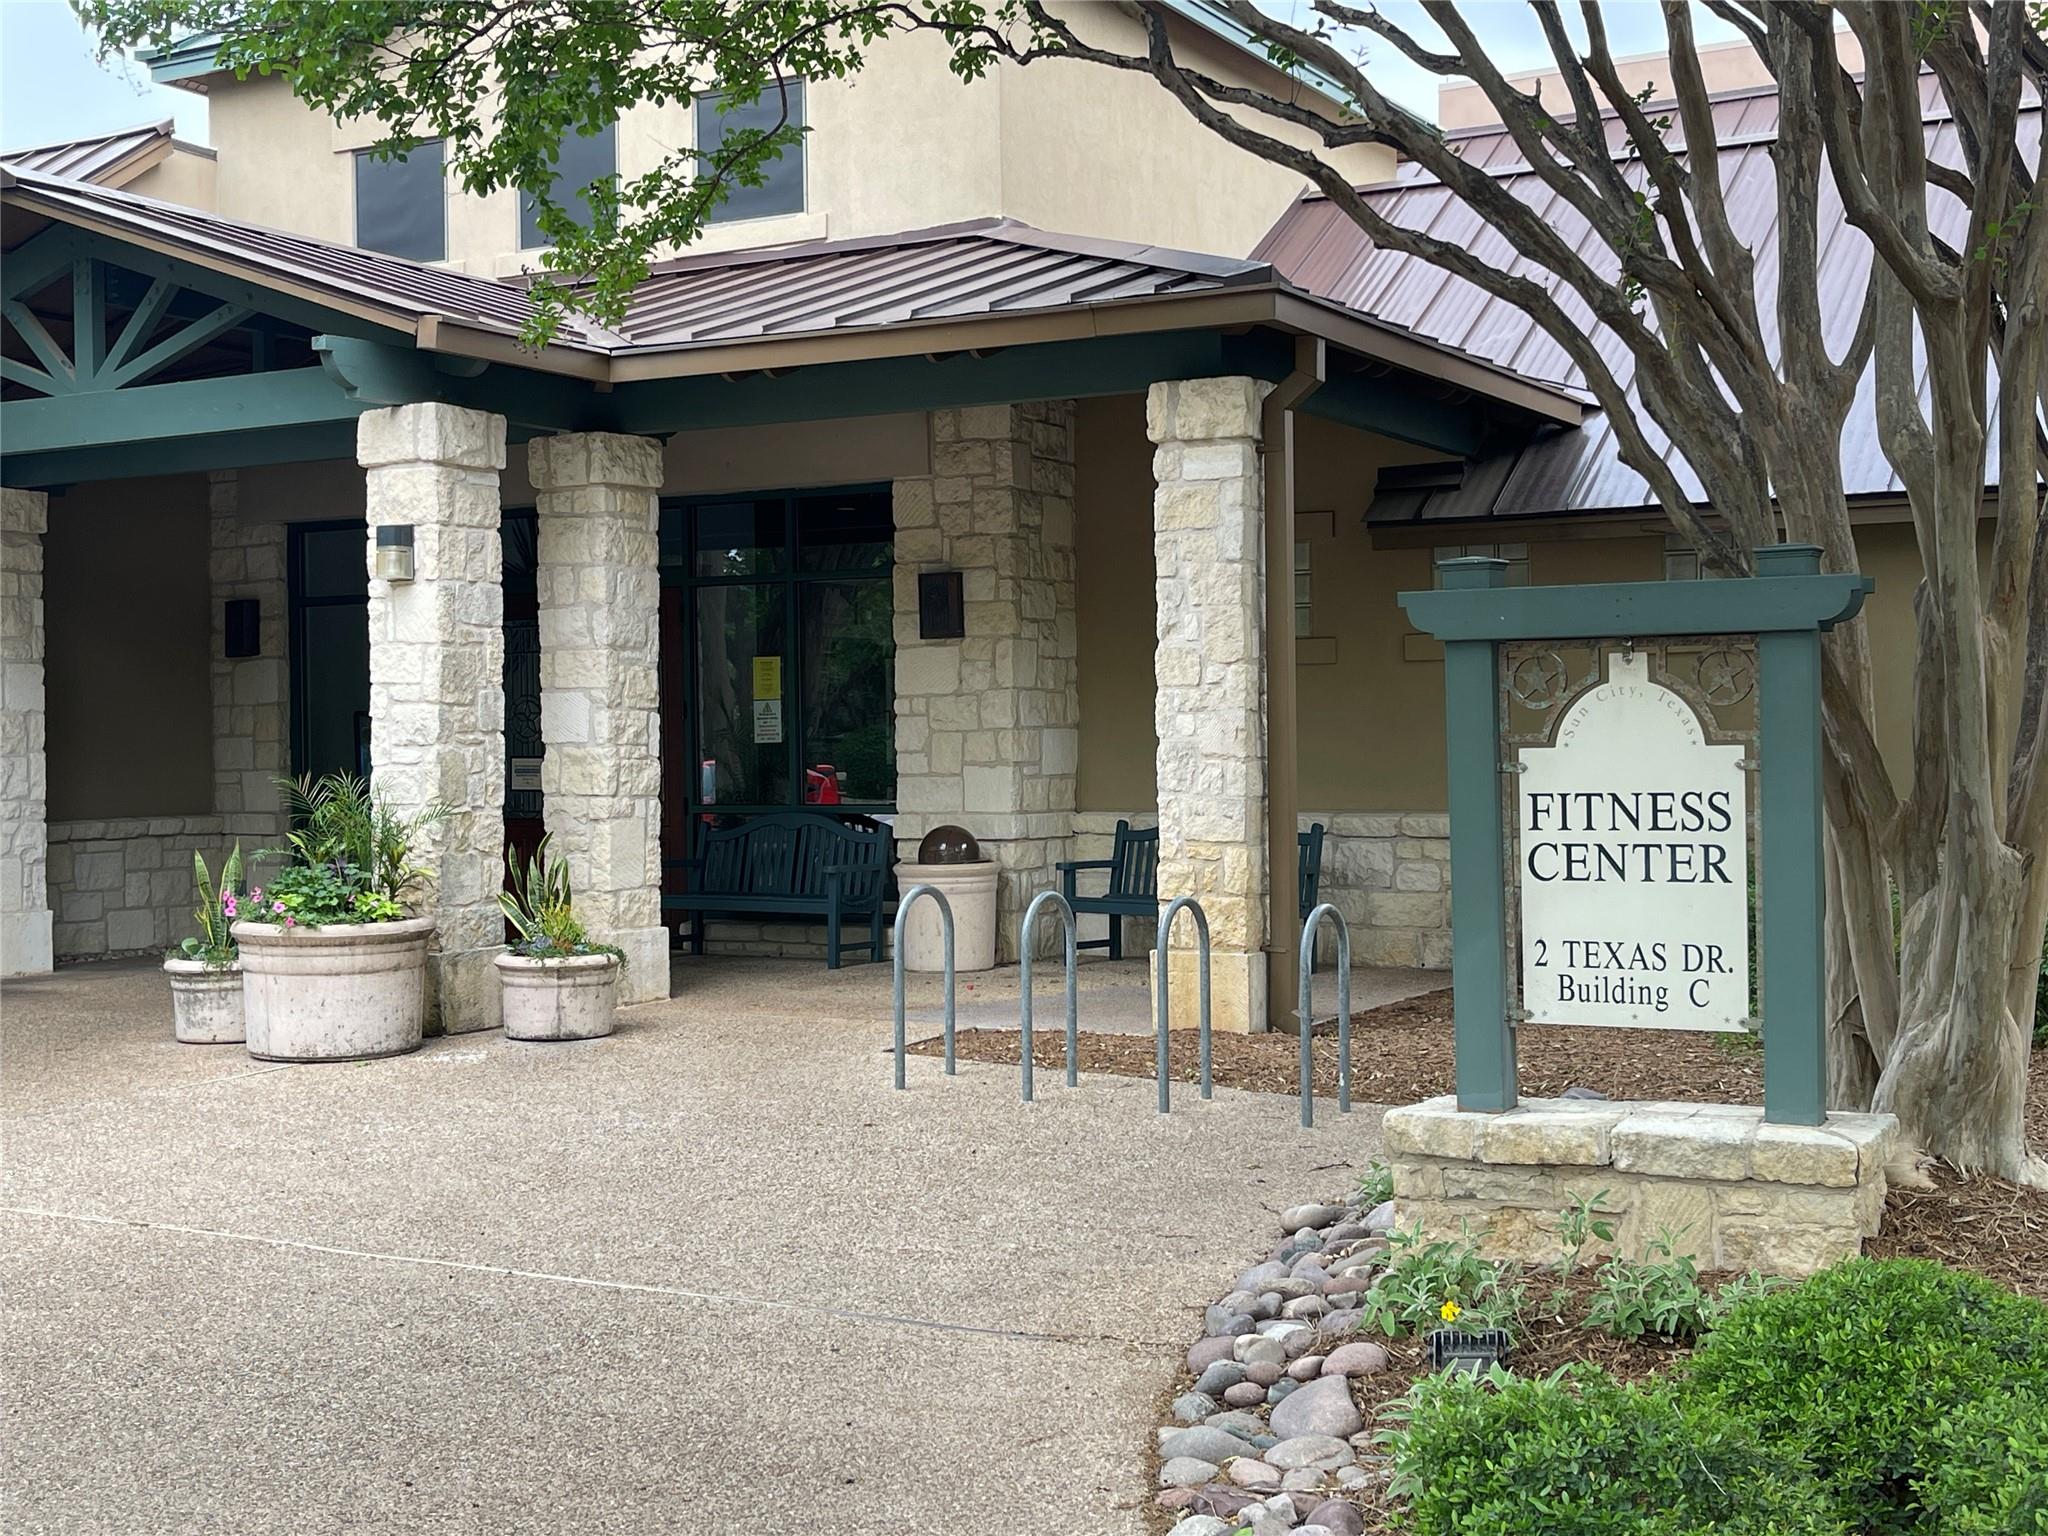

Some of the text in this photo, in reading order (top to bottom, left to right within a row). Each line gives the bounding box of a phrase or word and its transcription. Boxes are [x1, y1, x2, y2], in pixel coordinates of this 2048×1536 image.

[1563, 706, 1589, 739] Sun
[1656, 689, 1696, 735] Texas
[1527, 791, 1733, 832] FITNESS
[1527, 842, 1733, 884] CENTER
[1534, 938, 1734, 974] 2 TEXAS DR.
[1557, 973, 1710, 1012] Building C
